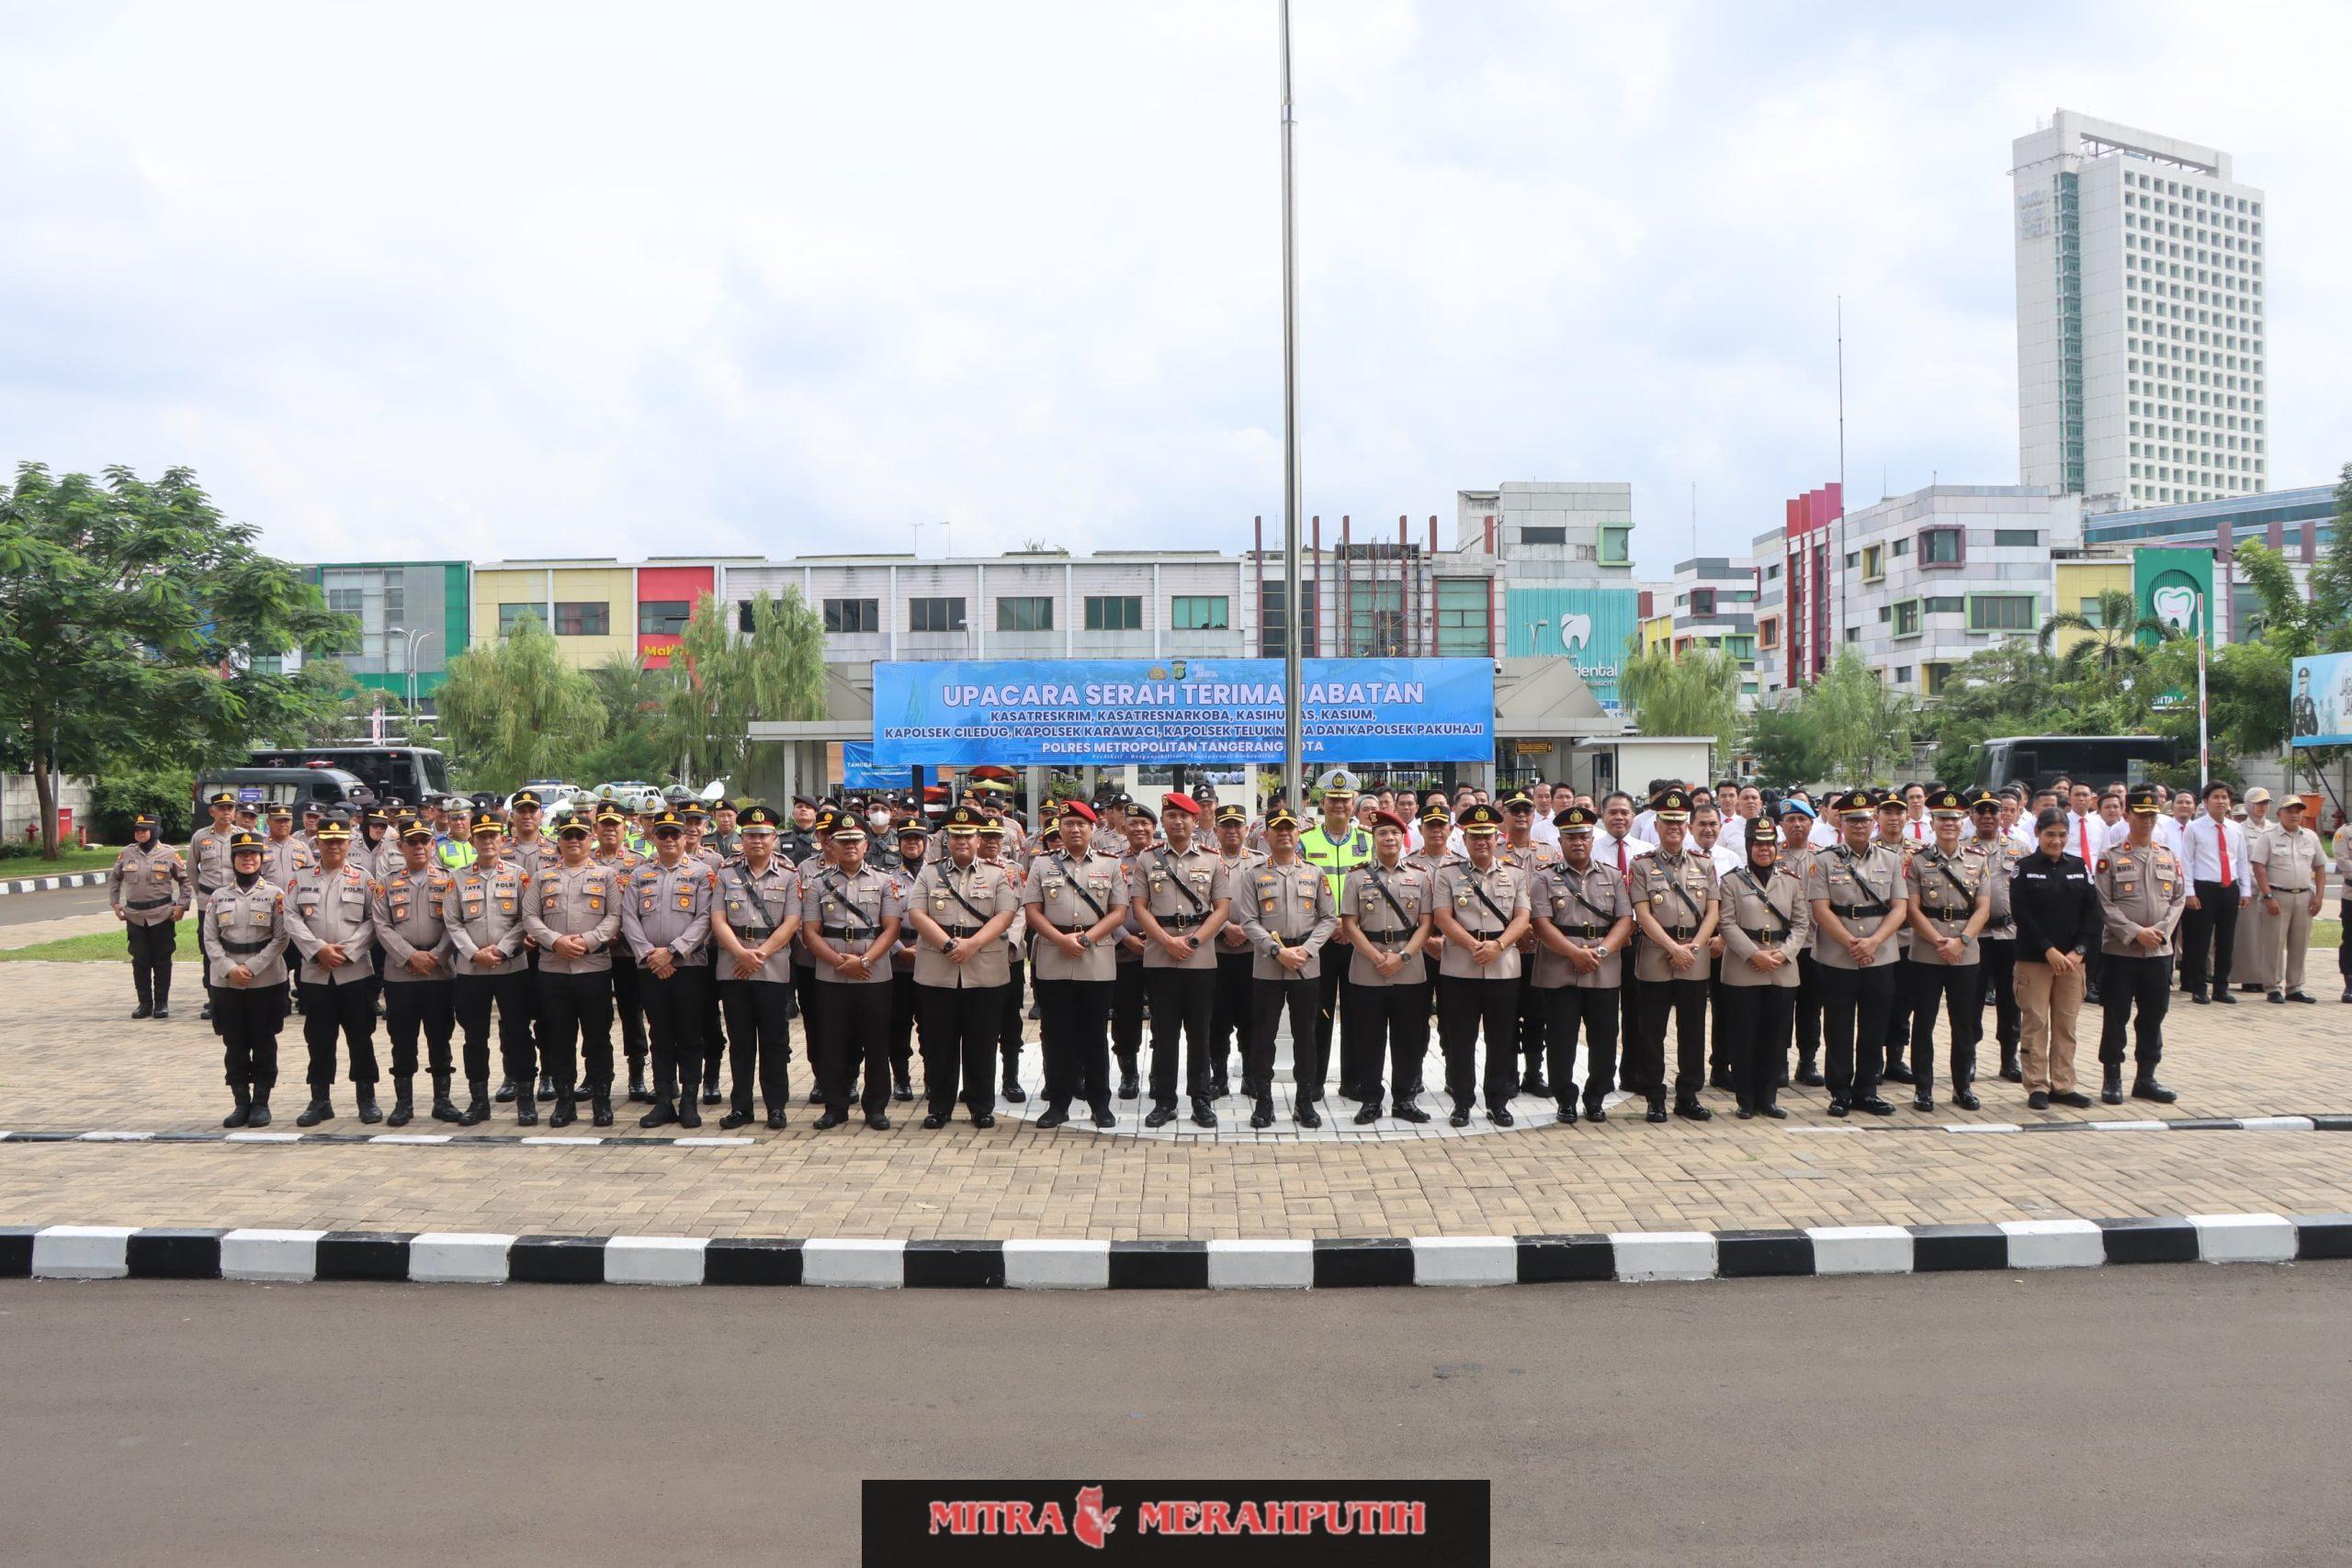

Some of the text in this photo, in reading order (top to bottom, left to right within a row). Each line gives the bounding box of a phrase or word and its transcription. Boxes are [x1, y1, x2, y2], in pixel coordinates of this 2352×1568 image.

[943, 684, 1080, 706] UPACARA
[1085, 683, 1175, 706] SERAH
[1182, 682, 1285, 705] TERIMA
[990, 707, 1376, 723] KASATRESKRIM, KASATRESNARKOBA, KASIHUAS, KASIUM,
[885, 722, 1484, 739] KAPOLSEK CILEDUG, KAPOLSEK KARAWACI, KAPOLSEK TELUK NA DAN KAPOLSEK PAKUHAJI
[1042, 740, 1324, 754] POLRES METROPOLITAN TANGERANG OTA
